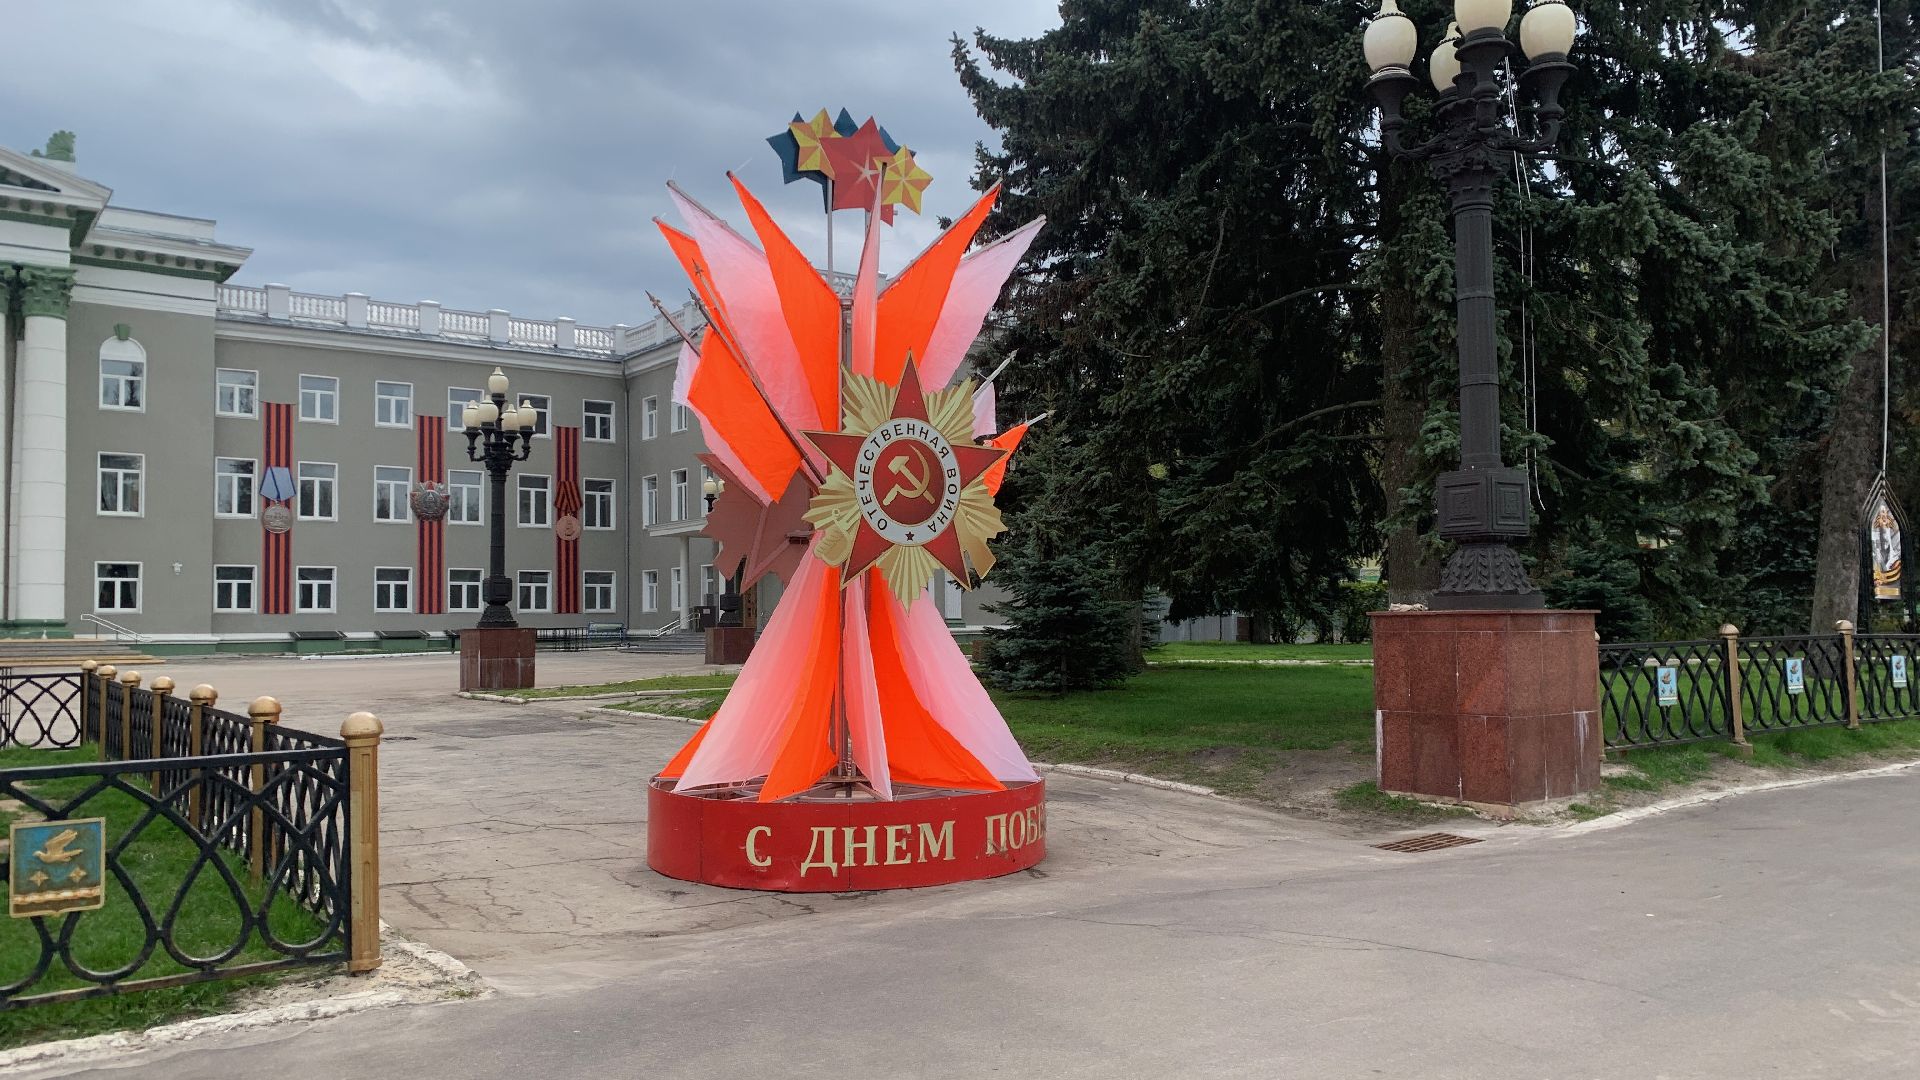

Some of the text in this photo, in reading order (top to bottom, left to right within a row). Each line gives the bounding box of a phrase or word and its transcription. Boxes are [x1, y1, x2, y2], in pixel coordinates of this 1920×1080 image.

[859, 423, 950, 531] ОТЕЧЕСТВЕННАЯ
[745, 825, 772, 867] С
[800, 820, 955, 877] ДНЕМ
